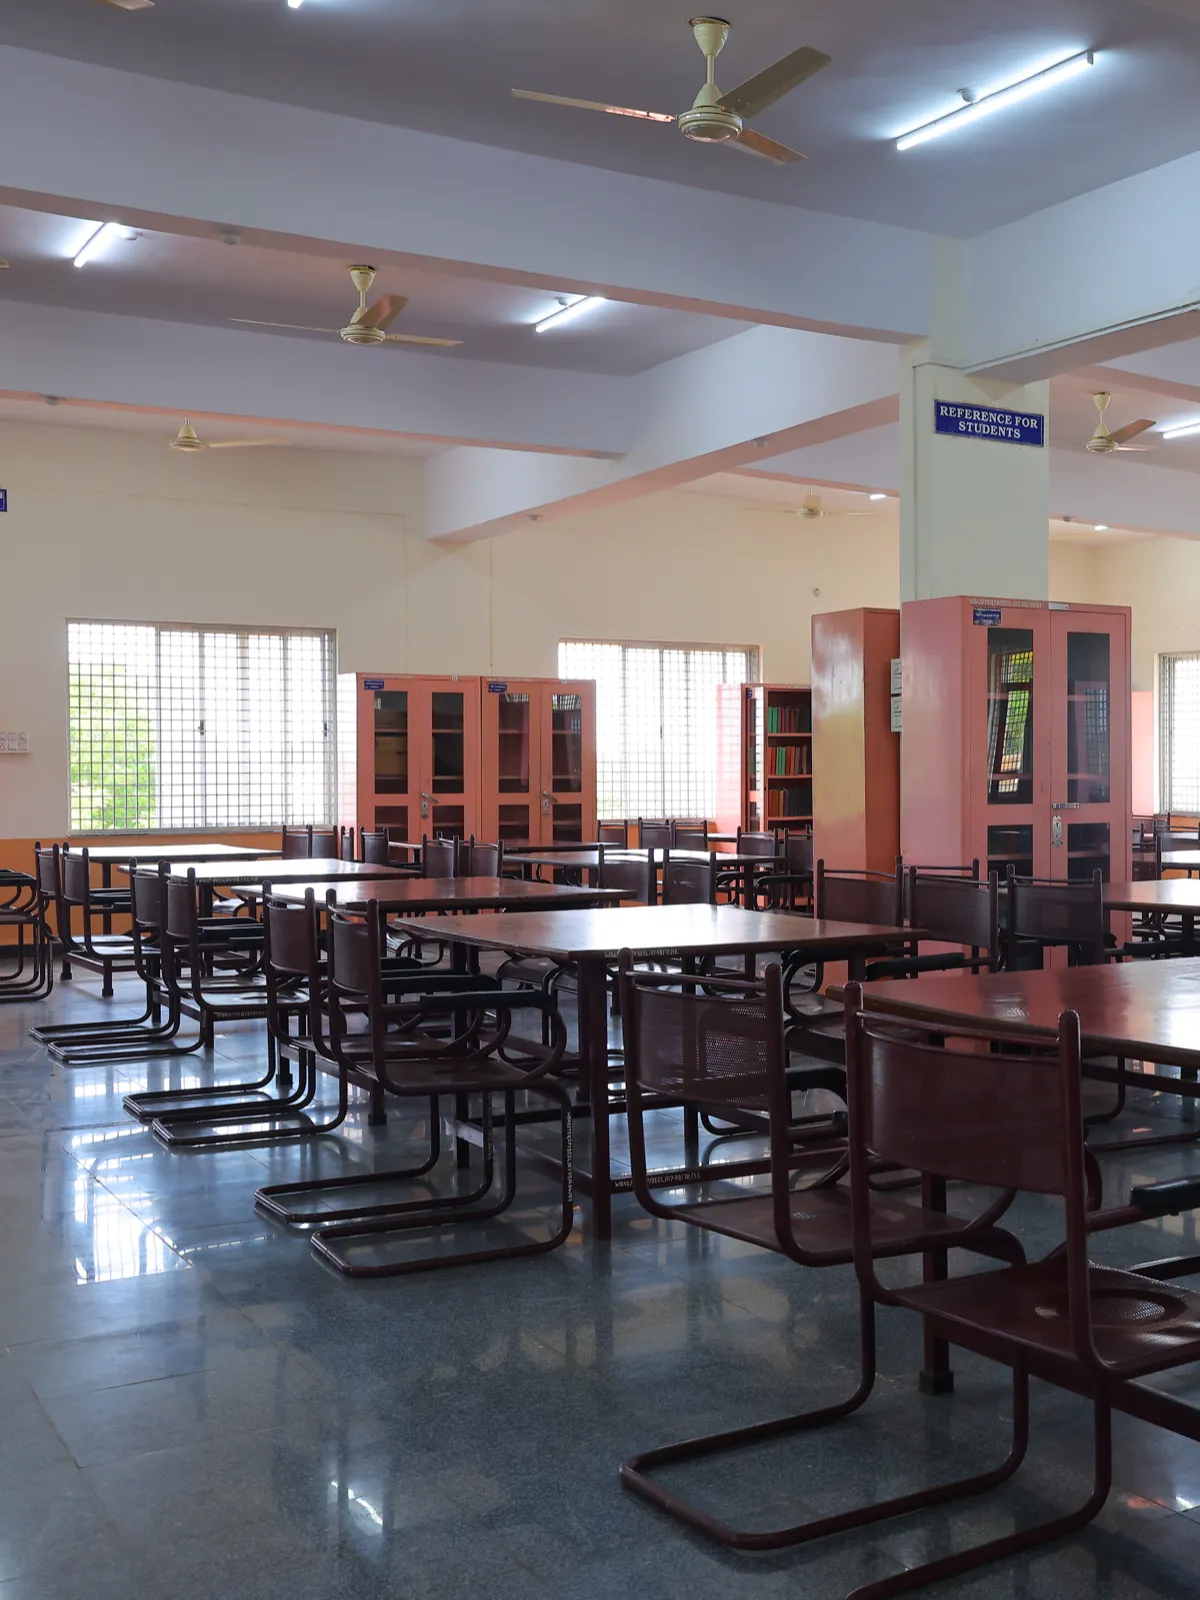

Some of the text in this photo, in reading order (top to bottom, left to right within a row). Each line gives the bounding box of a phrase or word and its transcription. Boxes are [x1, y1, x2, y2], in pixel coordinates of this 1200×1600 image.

[940, 405, 1039, 429] REFERENCE FOR
[959, 421, 1021, 439] STUDENTS
